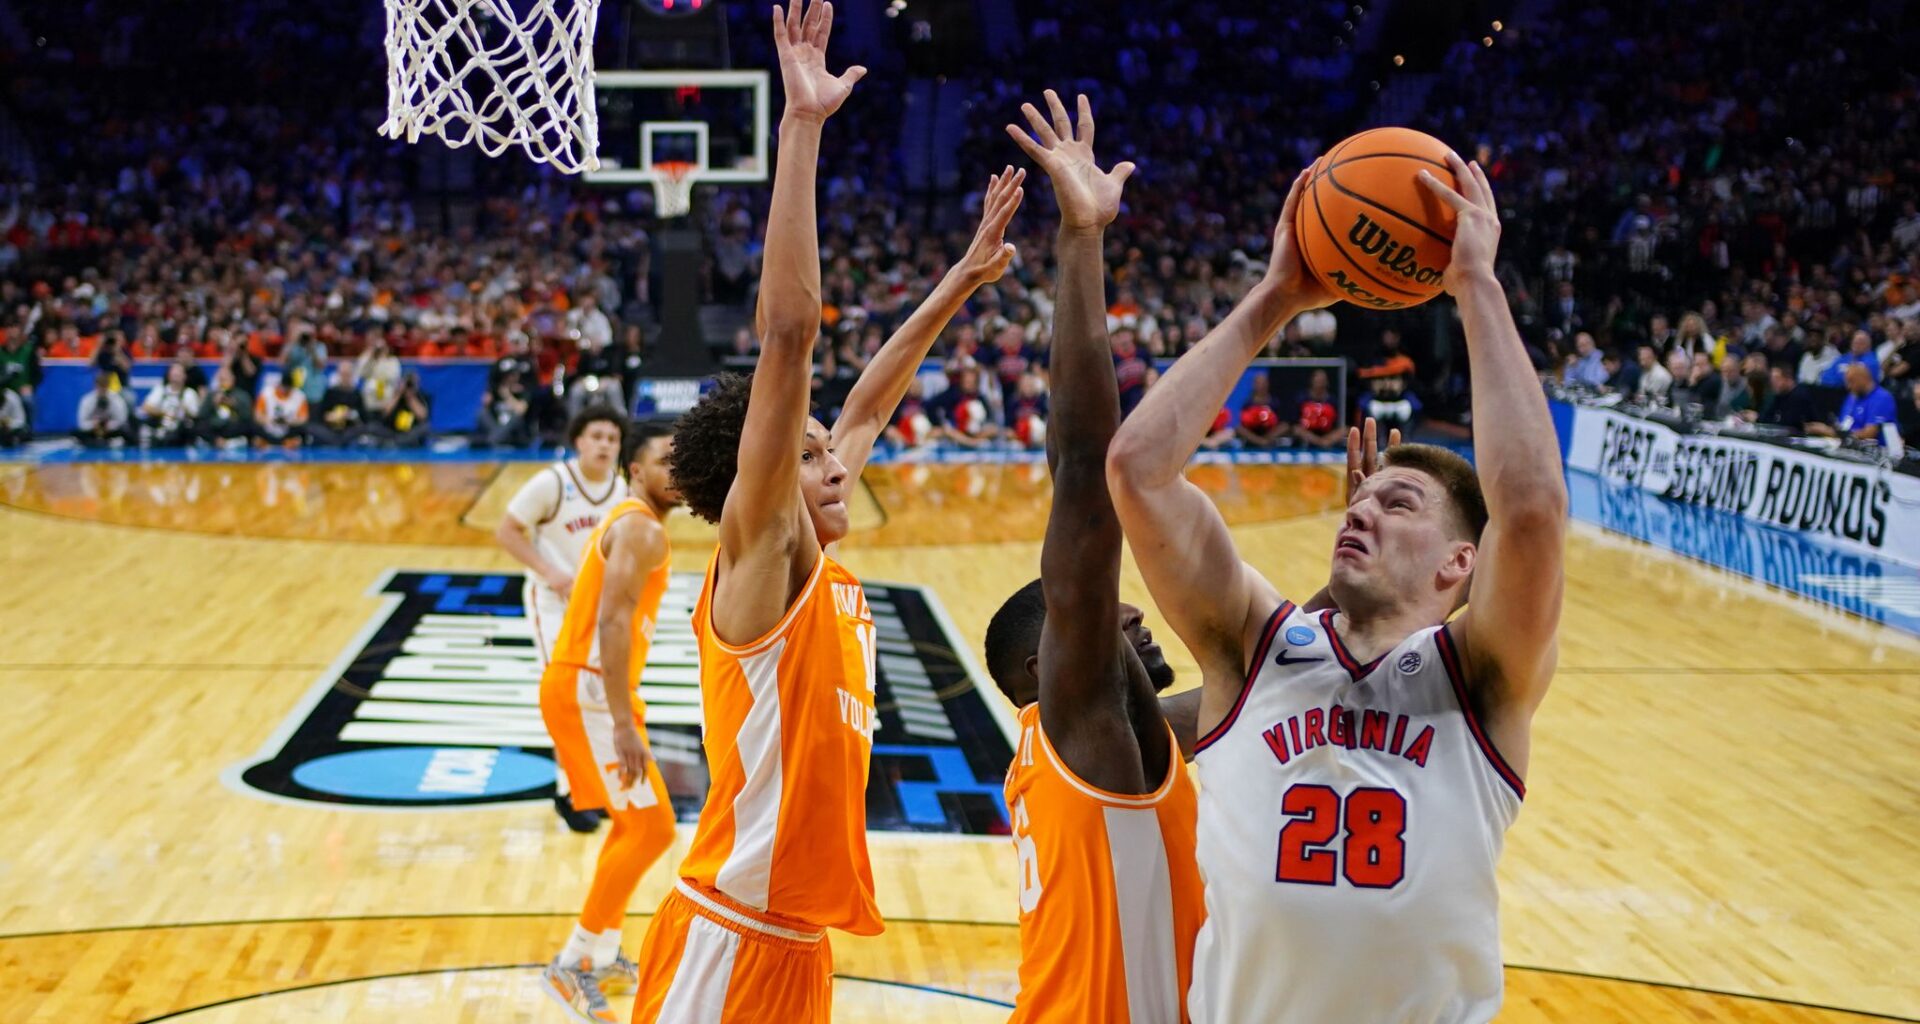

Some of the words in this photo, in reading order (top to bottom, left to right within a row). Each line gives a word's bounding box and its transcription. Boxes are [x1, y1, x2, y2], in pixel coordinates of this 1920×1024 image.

[1348, 212, 1444, 288] Wilson
[1601, 418, 1656, 488] FIRST
[1667, 442, 1759, 512] SECOND
[1760, 458, 1891, 548] ROUNDS
[1262, 704, 1436, 768] VIRGINIA
[1275, 783, 1407, 889] 28
